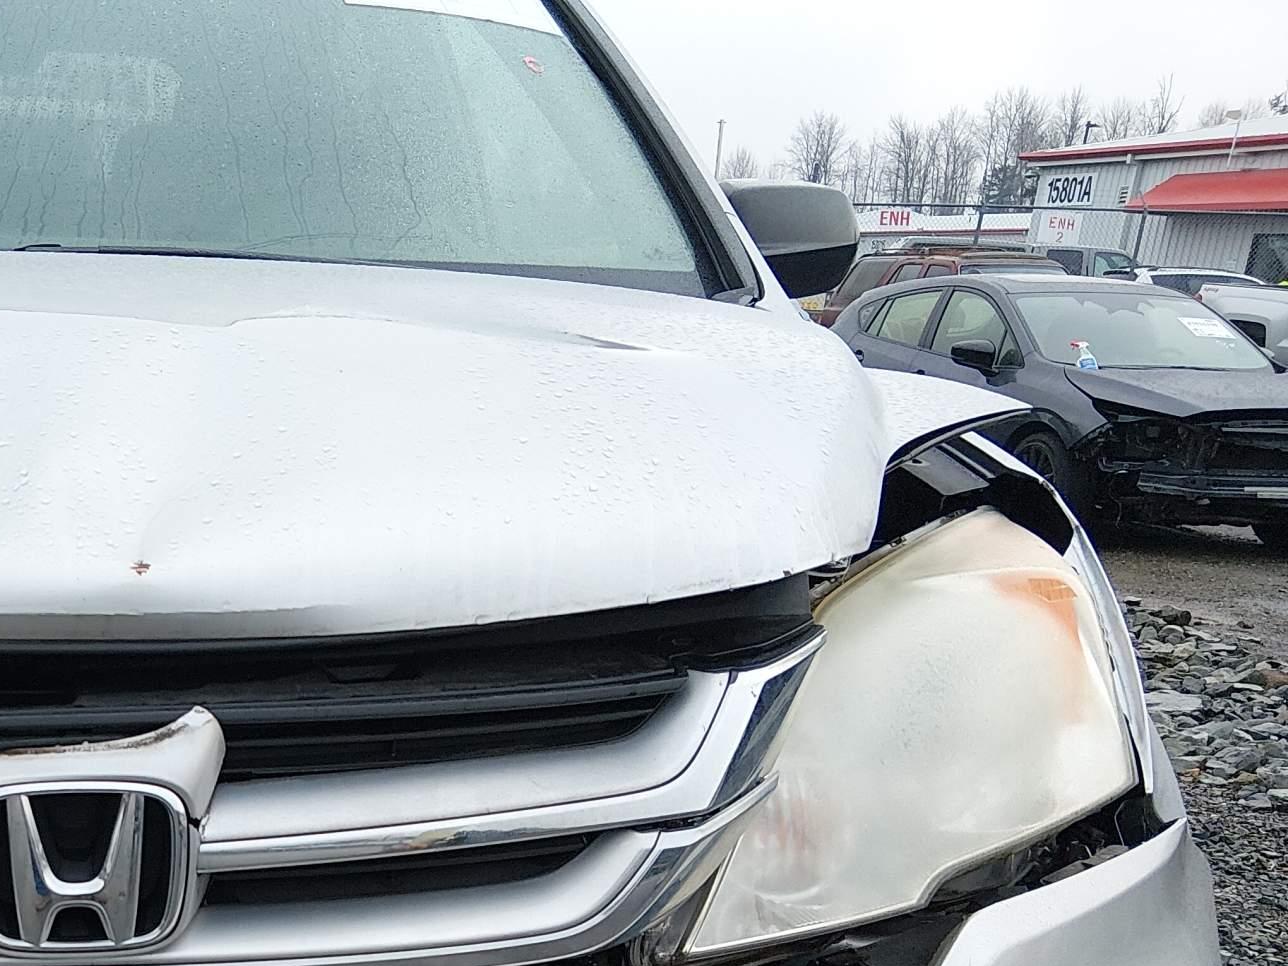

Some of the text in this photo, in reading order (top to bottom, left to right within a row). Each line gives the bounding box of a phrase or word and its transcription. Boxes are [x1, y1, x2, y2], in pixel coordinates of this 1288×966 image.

[1047, 175, 1093, 204] 15801A
[879, 210, 911, 226] ENH
[1048, 216, 1075, 230] ENH
[1055, 231, 1064, 243] 2
